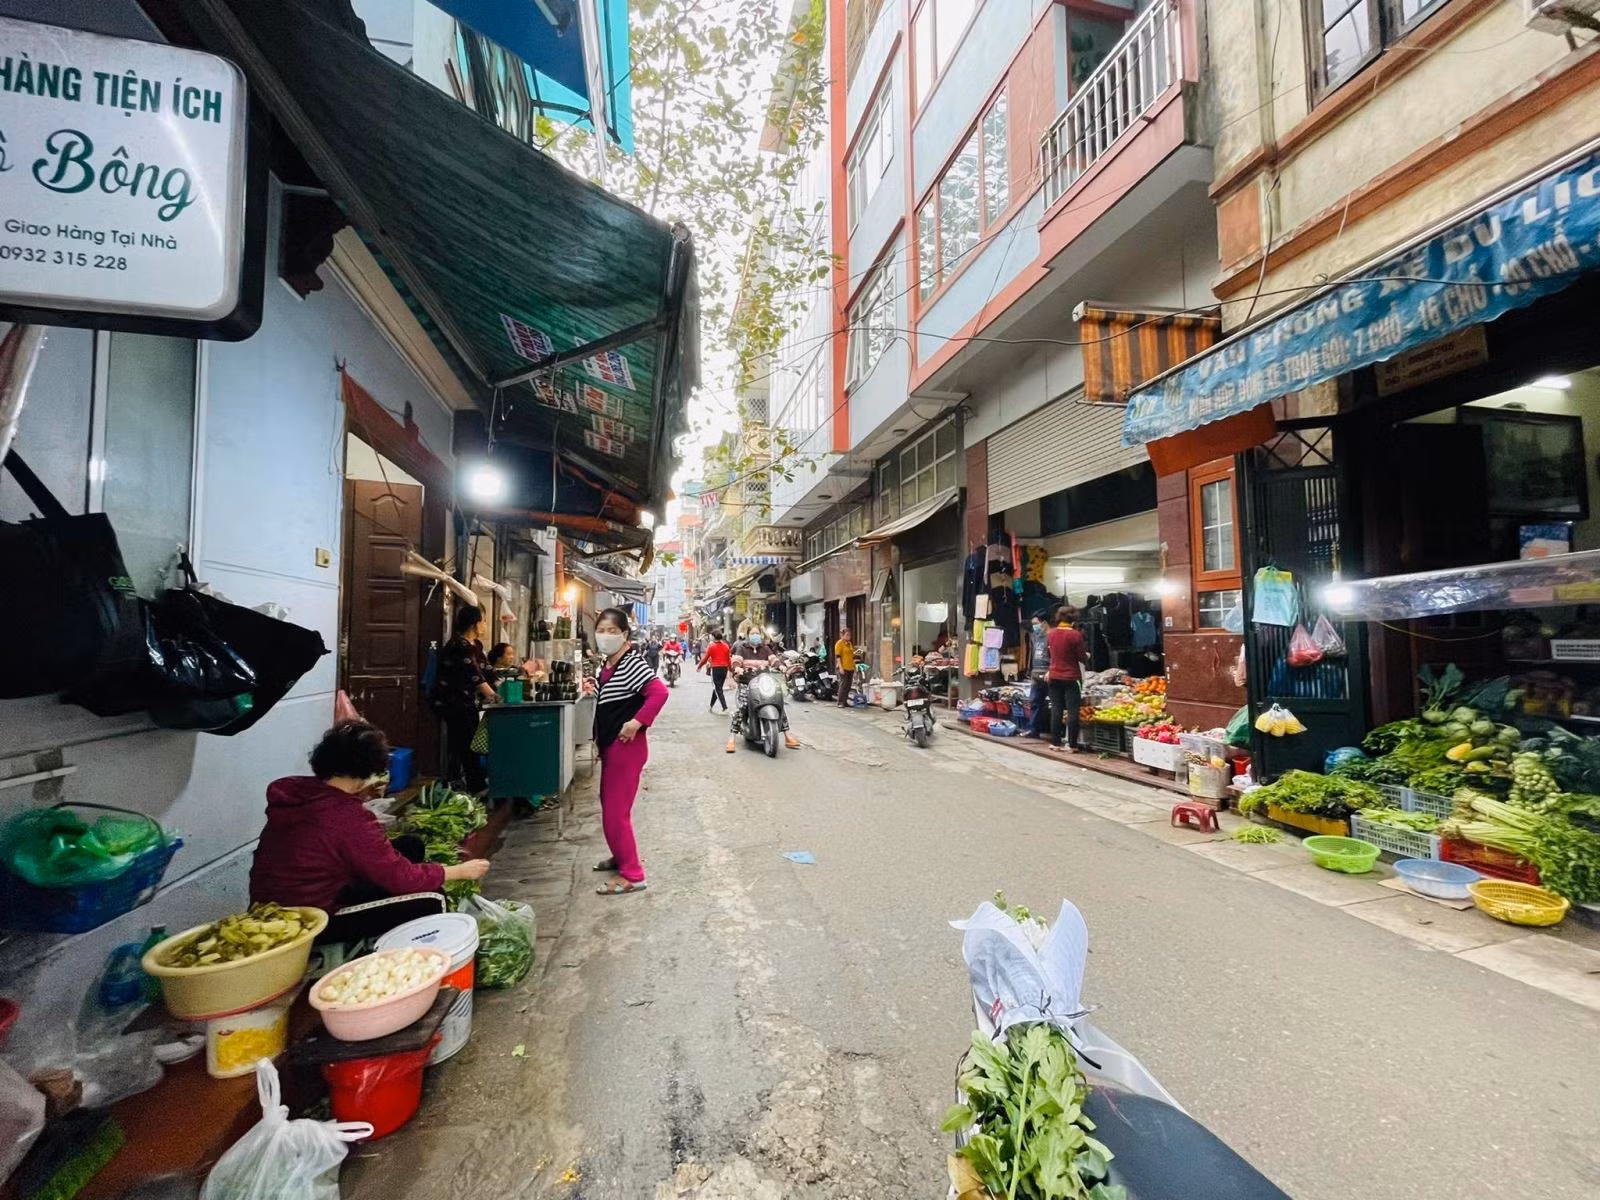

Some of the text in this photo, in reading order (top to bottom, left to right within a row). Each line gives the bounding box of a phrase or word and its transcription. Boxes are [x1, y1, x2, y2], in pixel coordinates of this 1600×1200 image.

[0, 51, 223, 123] HÀNG TIỆN ÍCH
[32, 128, 199, 222] Bông
[0, 245, 128, 271] 0932 315 228
[4, 219, 177, 250] Giao Hàng Tại Nhà
